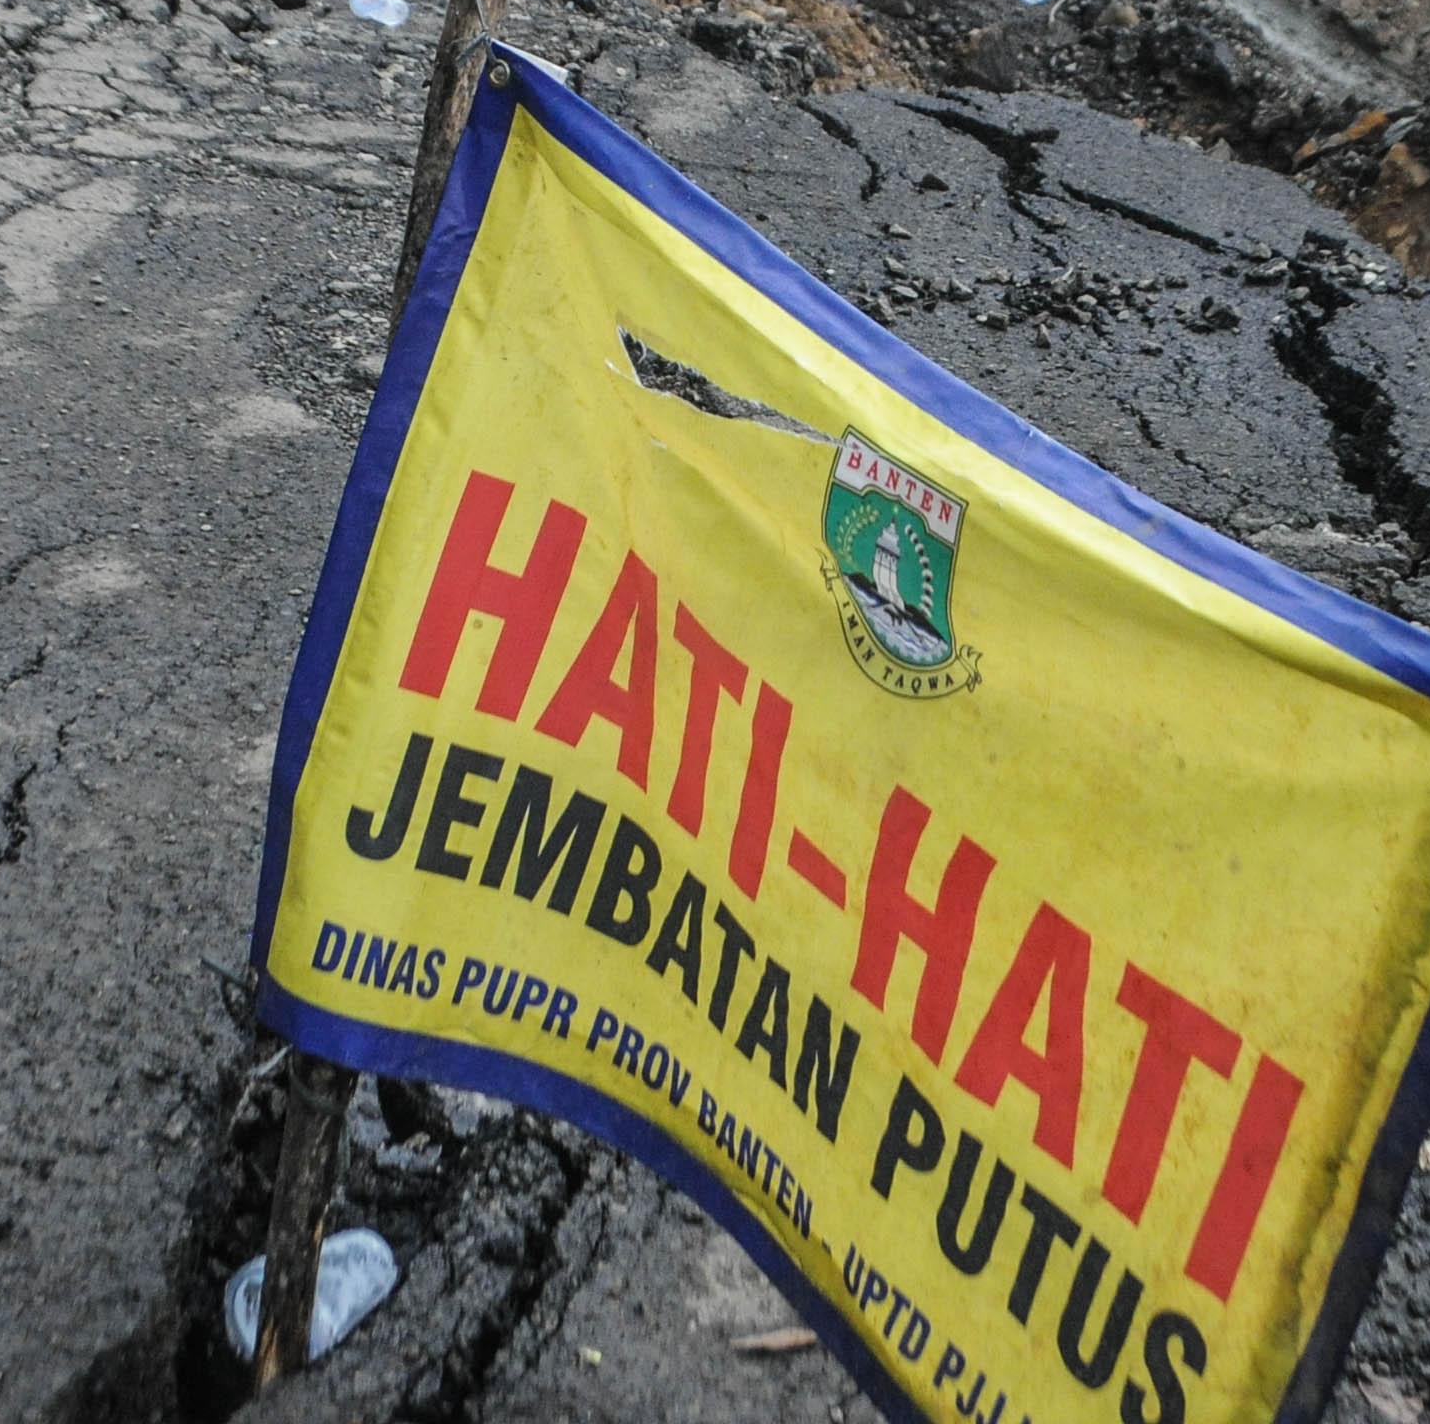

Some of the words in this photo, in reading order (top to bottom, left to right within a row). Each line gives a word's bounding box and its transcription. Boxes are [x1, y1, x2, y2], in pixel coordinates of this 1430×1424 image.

[841, 600, 876, 663] IMAN
[882, 665, 955, 697] TAQWA
[846, 444, 953, 523] BANTEN
[344, 731, 862, 1146] JEMBATAN
[869, 1072, 1208, 1424] PUTUS
[398, 468, 1306, 1307] HATI-HATI
[310, 919, 447, 1001] DINAS
[451, 956, 579, 1041] PUPR
[585, 1006, 693, 1110] PROV
[697, 1087, 814, 1242] BANTEN
[842, 1243, 932, 1364] UPTD
